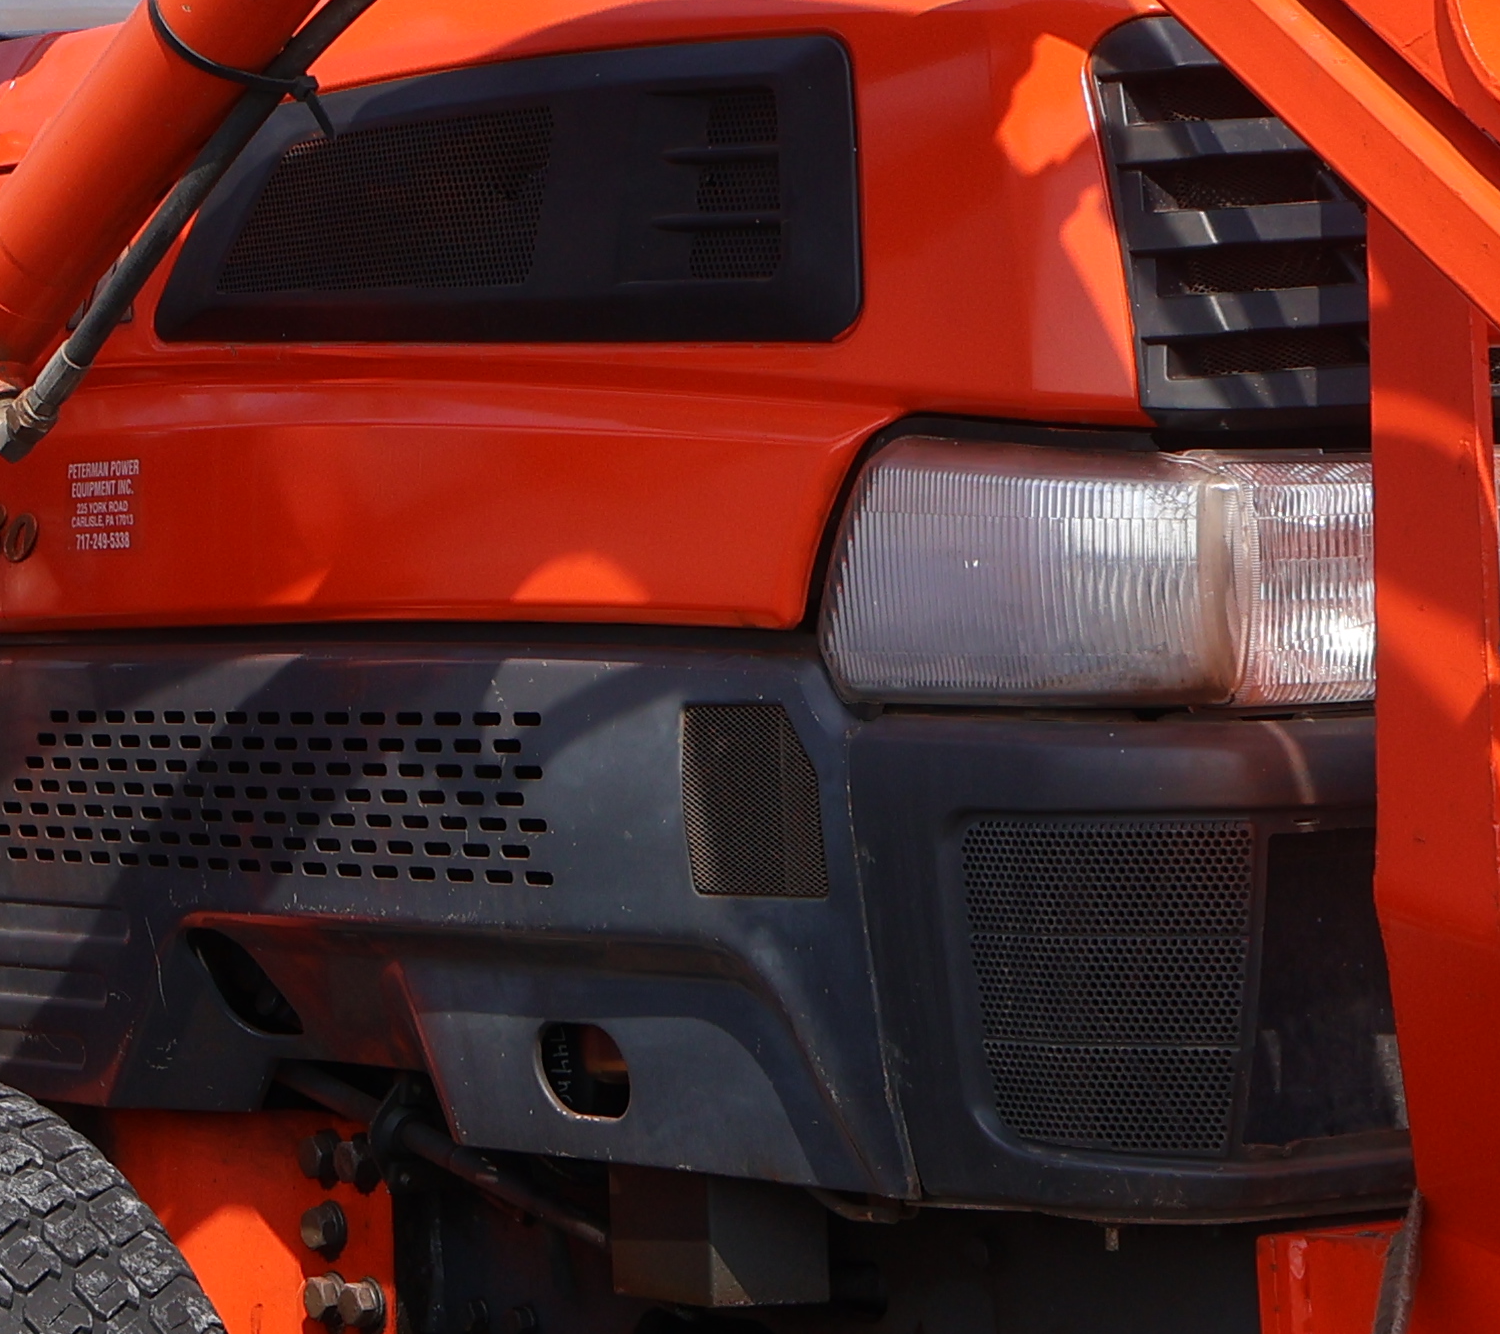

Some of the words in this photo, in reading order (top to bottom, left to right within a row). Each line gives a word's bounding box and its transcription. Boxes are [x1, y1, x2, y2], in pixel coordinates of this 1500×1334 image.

[68, 462, 109, 479] PETERMAN
[110, 459, 140, 477] POWER
[71, 480, 116, 498] EQUIPMENT
[117, 478, 134, 495] INC.
[76, 502, 87, 514] 225
[89, 501, 107, 513] YORK
[108, 500, 129, 513] ROAD
[71, 515, 105, 528] CARLISLE,
[105, 514, 115, 526] PA
[115, 514, 134, 526] 17013
